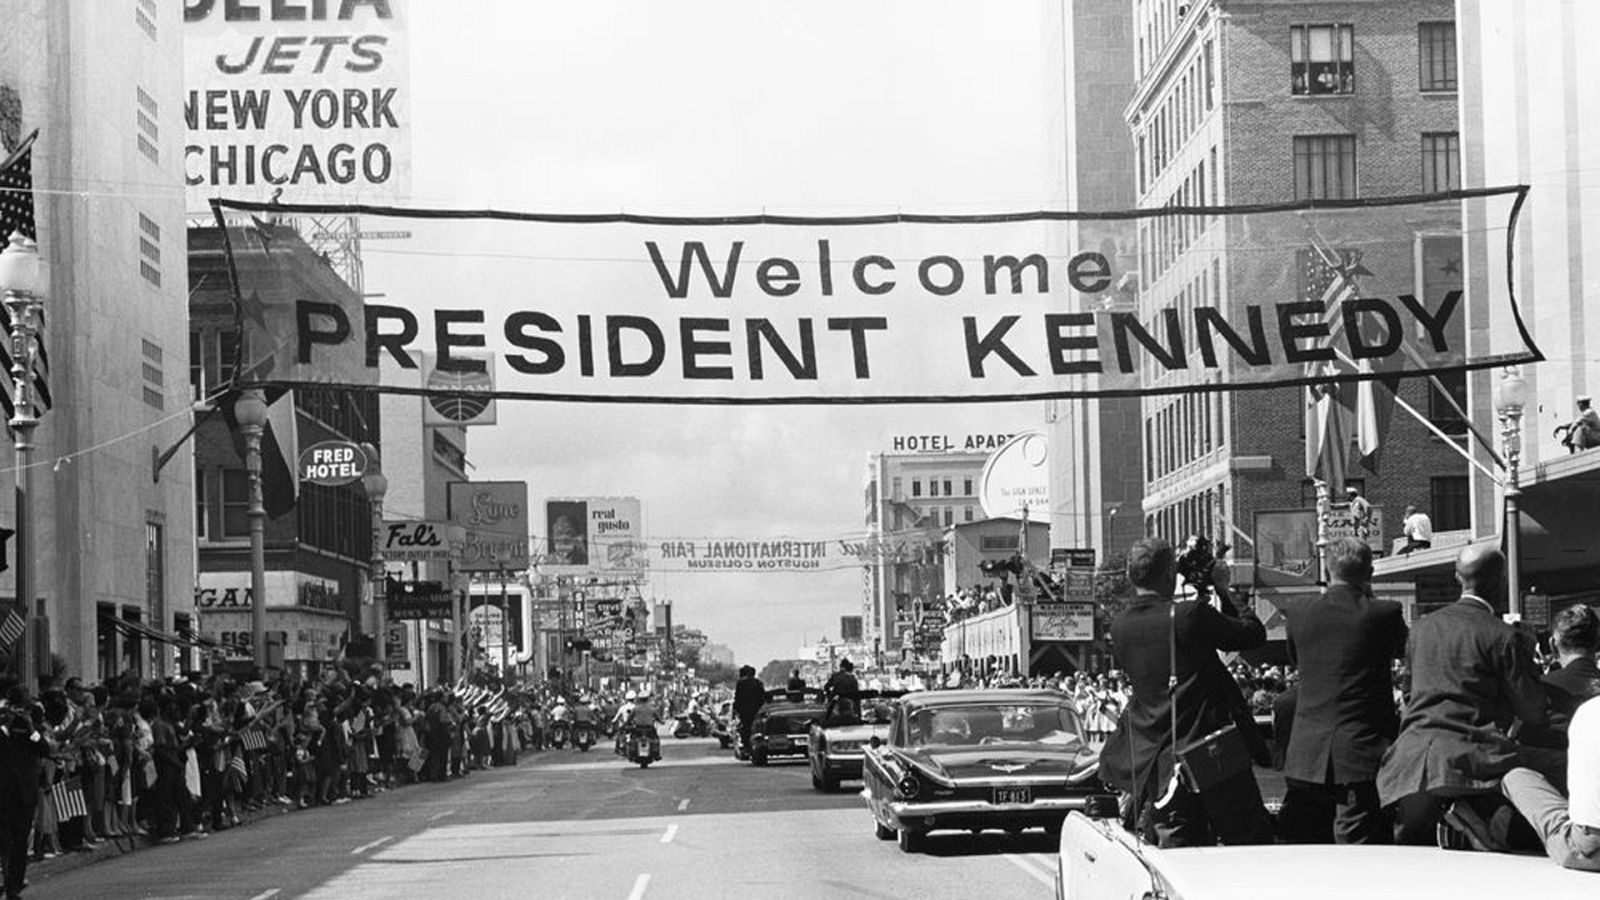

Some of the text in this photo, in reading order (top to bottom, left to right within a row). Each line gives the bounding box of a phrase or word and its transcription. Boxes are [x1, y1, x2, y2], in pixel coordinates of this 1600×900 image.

[215, 35, 388, 74] JETS
[184, 88, 400, 130] NEW YORK
[184, 143, 392, 186] CHICAGO
[645, 239, 1112, 299] Welcome
[295, 290, 1463, 380] PRESIDENT KENNEDY
[313, 447, 354, 464] FRED
[893, 436, 955, 450] HOTEL
[306, 461, 362, 479] HOTEL
[592, 508, 615, 520] real
[598, 520, 630, 533] gusto
[385, 523, 441, 548] Fal's
